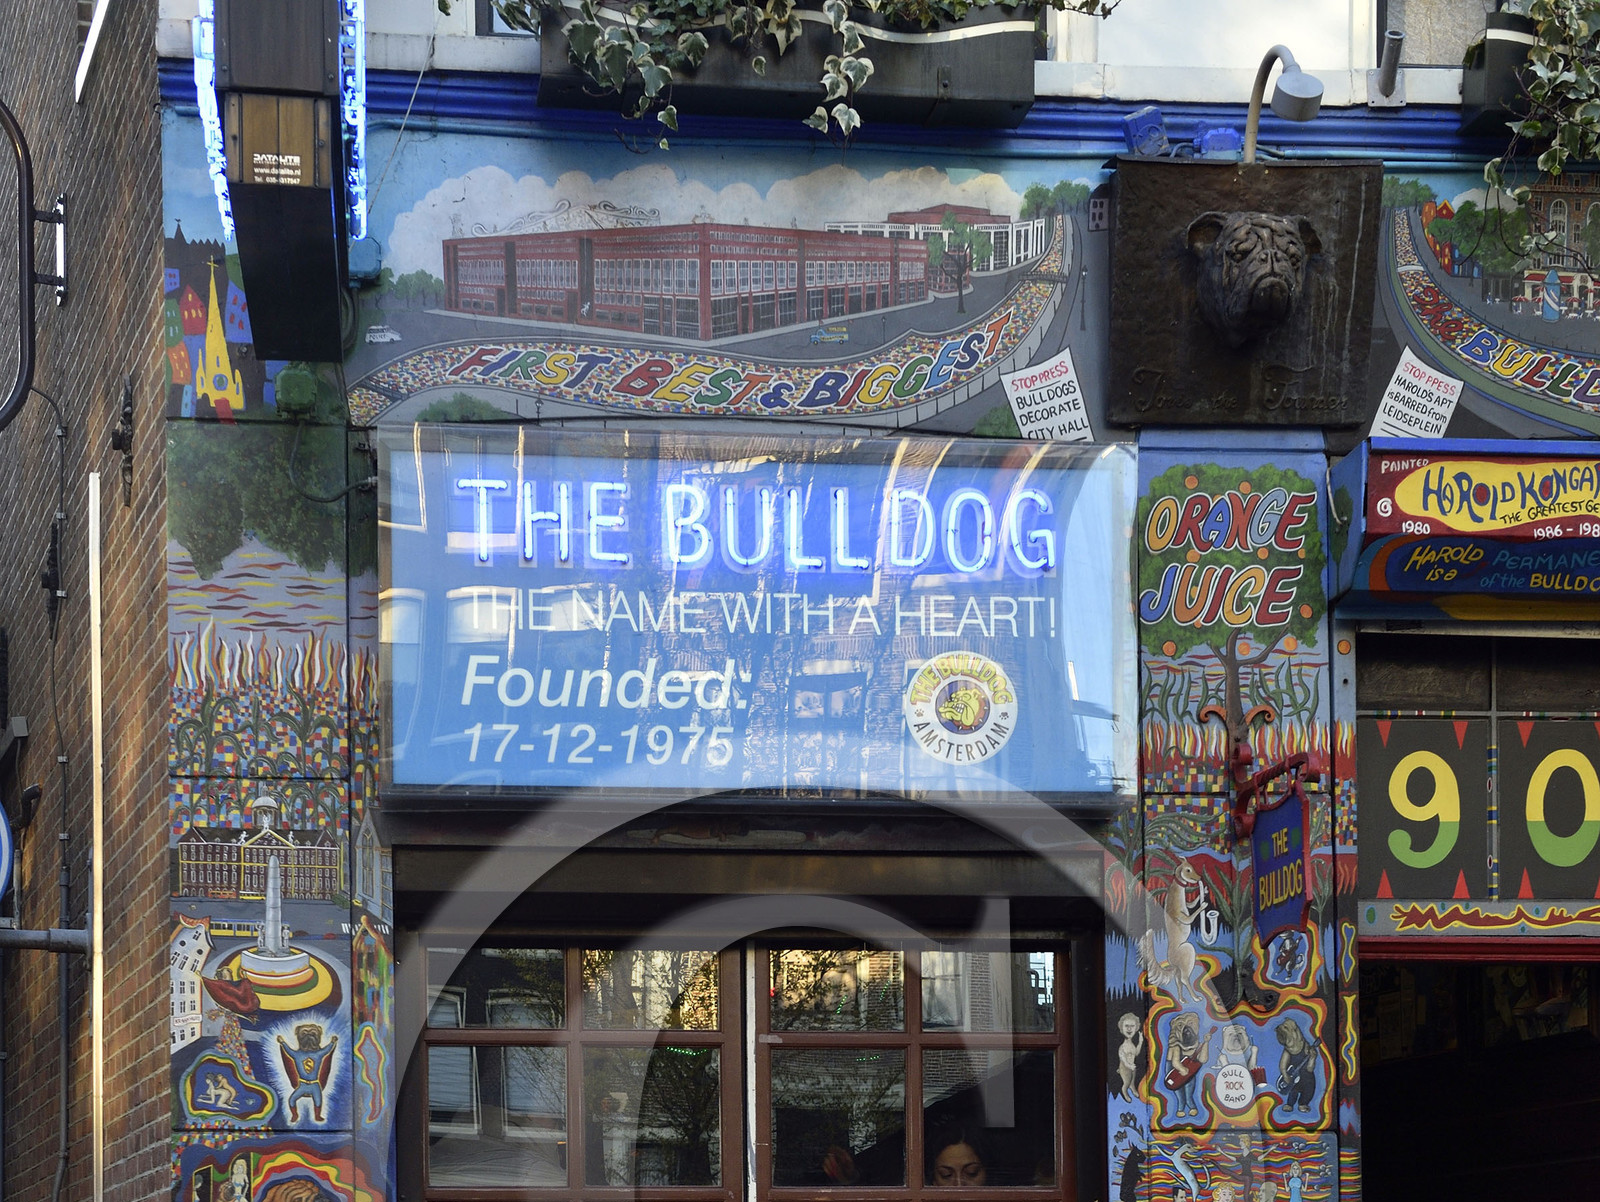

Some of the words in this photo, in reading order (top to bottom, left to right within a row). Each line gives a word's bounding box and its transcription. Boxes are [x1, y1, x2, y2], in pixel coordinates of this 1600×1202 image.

[610, 358, 776, 407] BEST
[796, 309, 1015, 408] BIGGEST
[1403, 362, 1426, 381] STOP
[1011, 375, 1038, 392] STOP
[1039, 361, 1069, 383] PRESS
[1015, 380, 1077, 410] BULLDOGS
[1433, 396, 1454, 409] APT
[1019, 398, 1081, 426] DECORATE
[1058, 417, 1089, 436] HALL
[1383, 402, 1442, 434] LEIDSEPLEIN
[1381, 458, 1429, 474] PAINTED
[1145, 487, 1317, 554] ORANGE
[1500, 511, 1522, 524] THE
[1528, 499, 1585, 520] GREATEST
[457, 478, 632, 566] THE
[661, 483, 1058, 577] BULLDOG
[1402, 520, 1431, 534] 1980
[1533, 524, 1563, 540] 1986
[1139, 562, 1304, 628] JUICE
[1501, 573, 1525, 588] the
[467, 590, 555, 630] THE
[570, 590, 706, 634] NAME
[707, 593, 834, 635] WITH
[847, 594, 882, 636] A
[895, 594, 1057, 638] HEART!
[461, 655, 752, 711] Founded:
[910, 665, 941, 705] THE
[934, 654, 1013, 705] BULLDOG
[463, 723, 735, 766] 17-12-1975
[913, 722, 1010, 761] AMSTERDAM
[1271, 827, 1289, 857] THE
[1259, 859, 1303, 912] BULLDOG
[1221, 1069, 1244, 1078] BULL
[1224, 1081, 1245, 1090] ROCK
[1223, 1094, 1246, 1102] BAND
